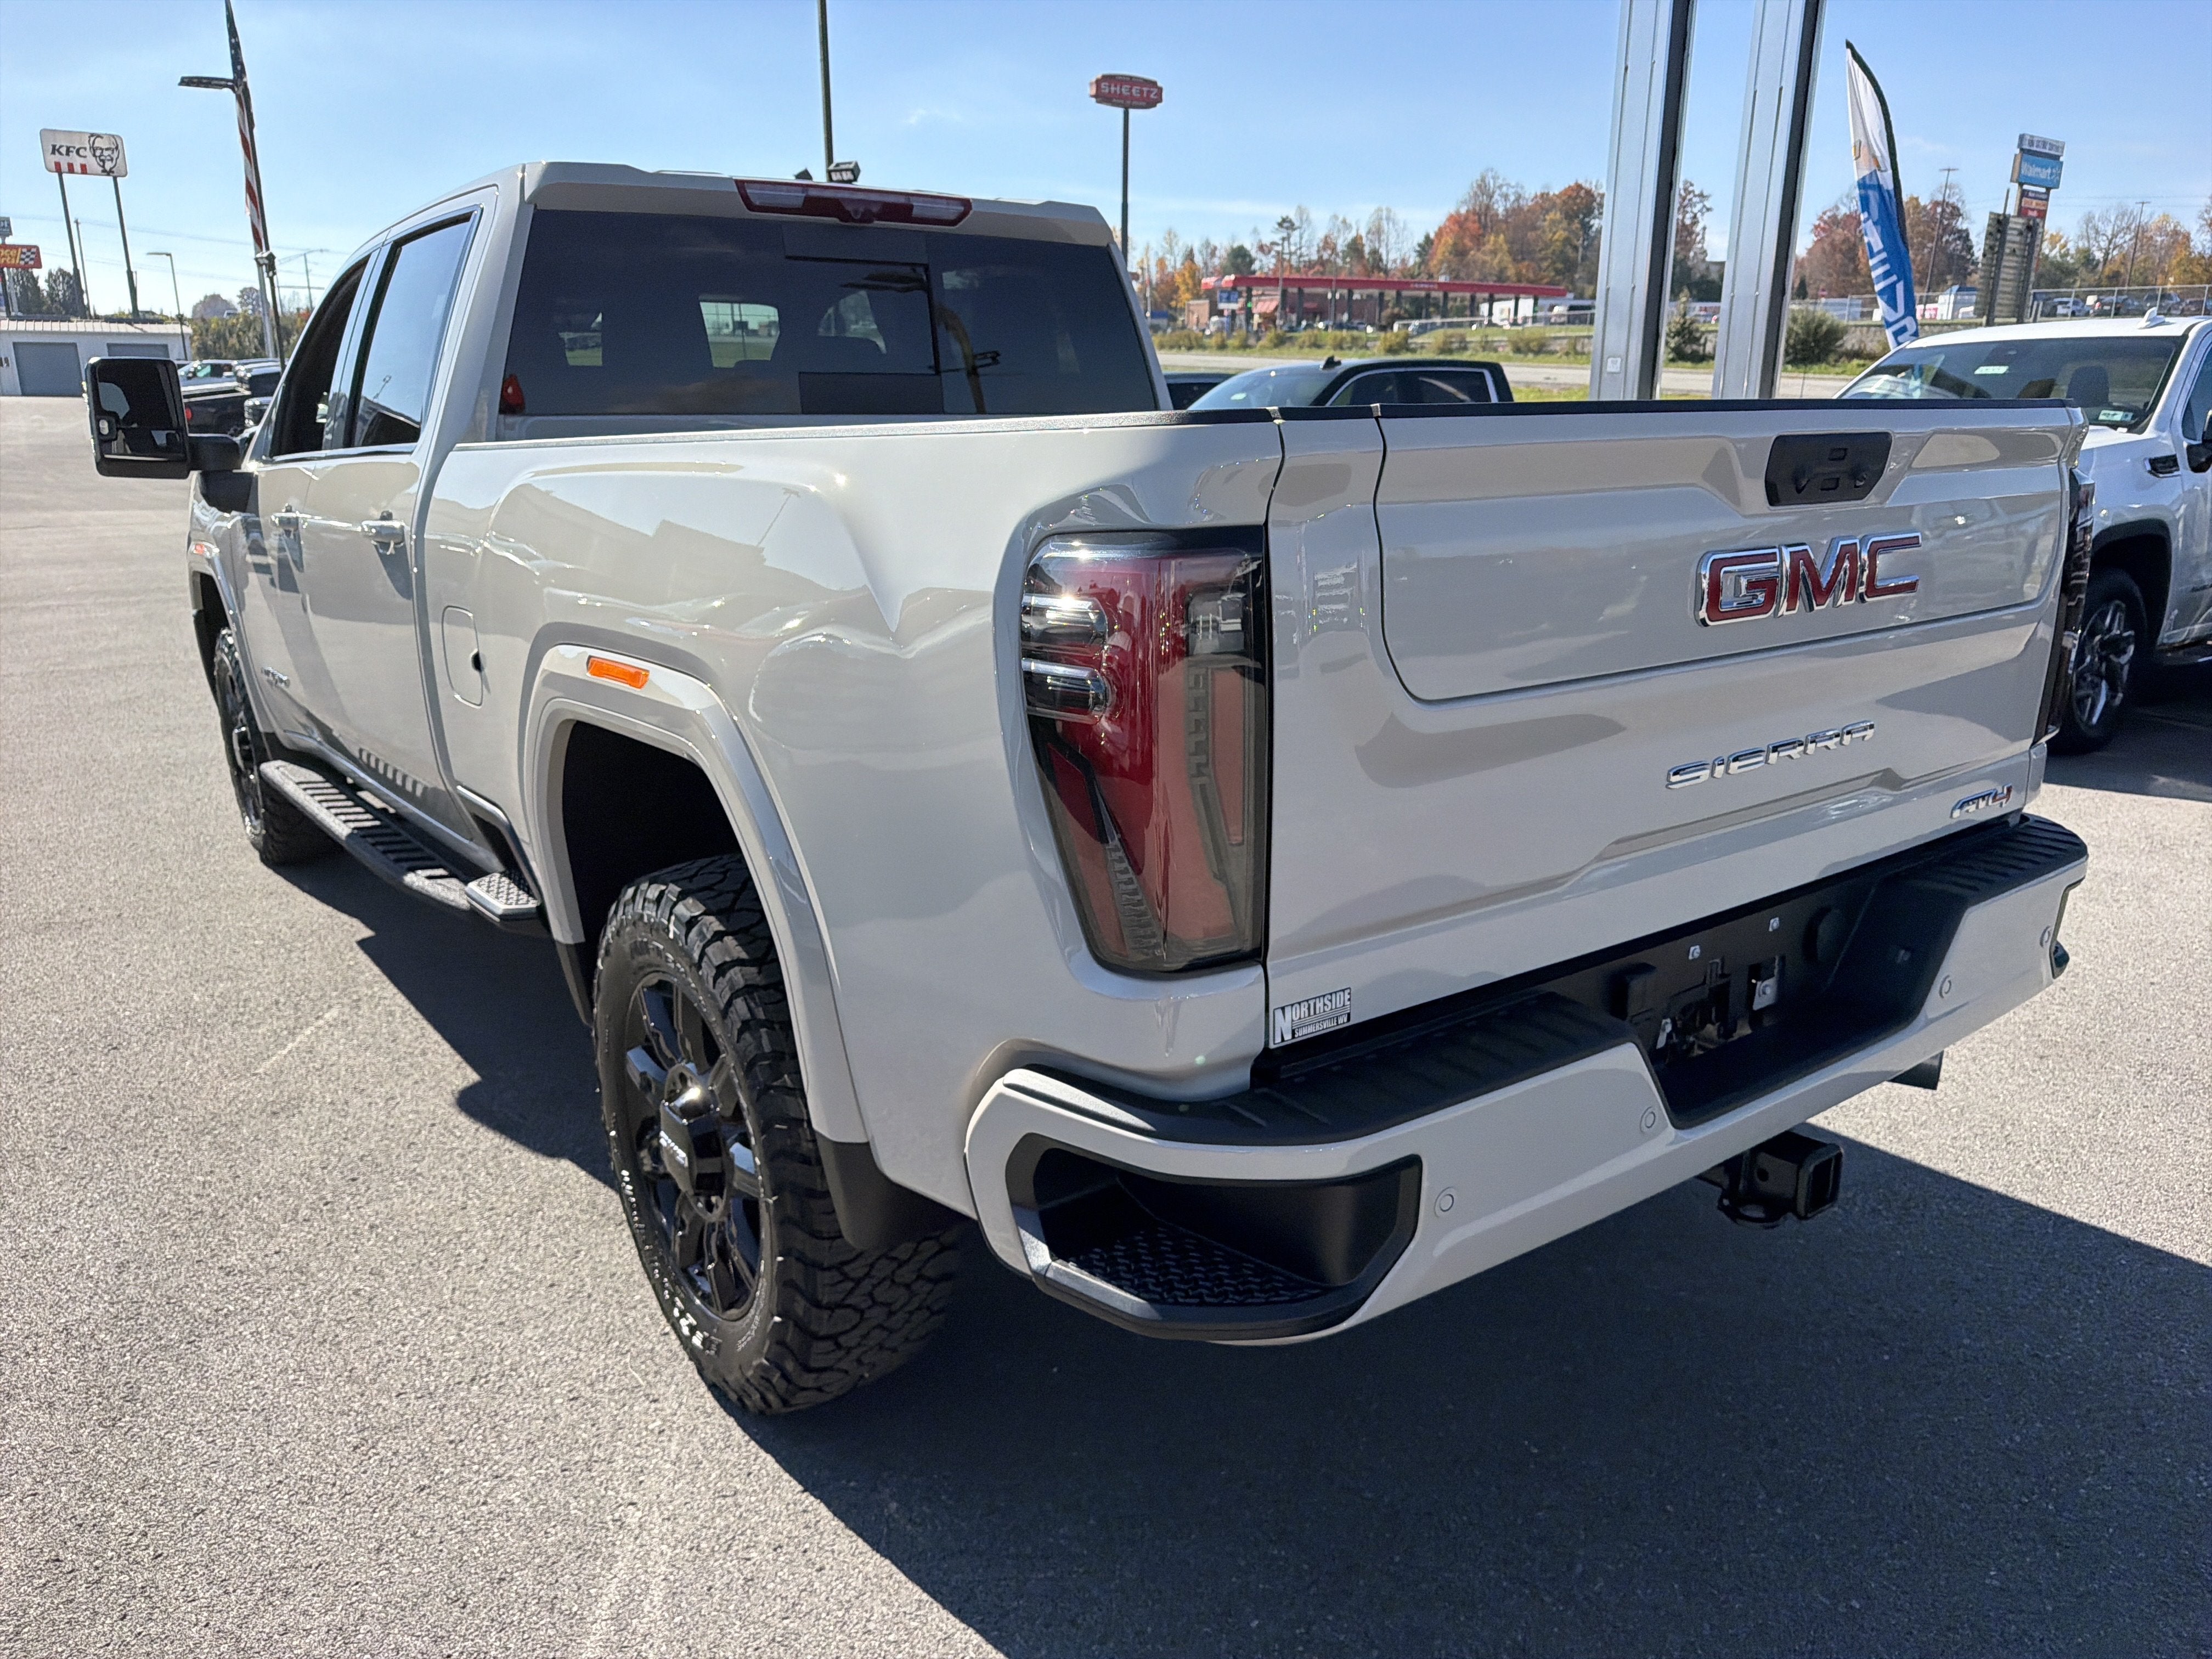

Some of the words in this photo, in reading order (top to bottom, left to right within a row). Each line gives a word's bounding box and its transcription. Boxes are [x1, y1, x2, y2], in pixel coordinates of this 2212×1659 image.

[1101, 82, 1159, 99] SHEETZ
[50, 144, 87, 158] KFC
[1695, 532, 1922, 627] GMC
[1666, 720, 1875, 790] SIERRA
[1274, 989, 1351, 1043] NORTHSIDE
[1294, 1017, 1338, 1038] SUMMERSVILLE
[1338, 1013, 1347, 1025] WV
